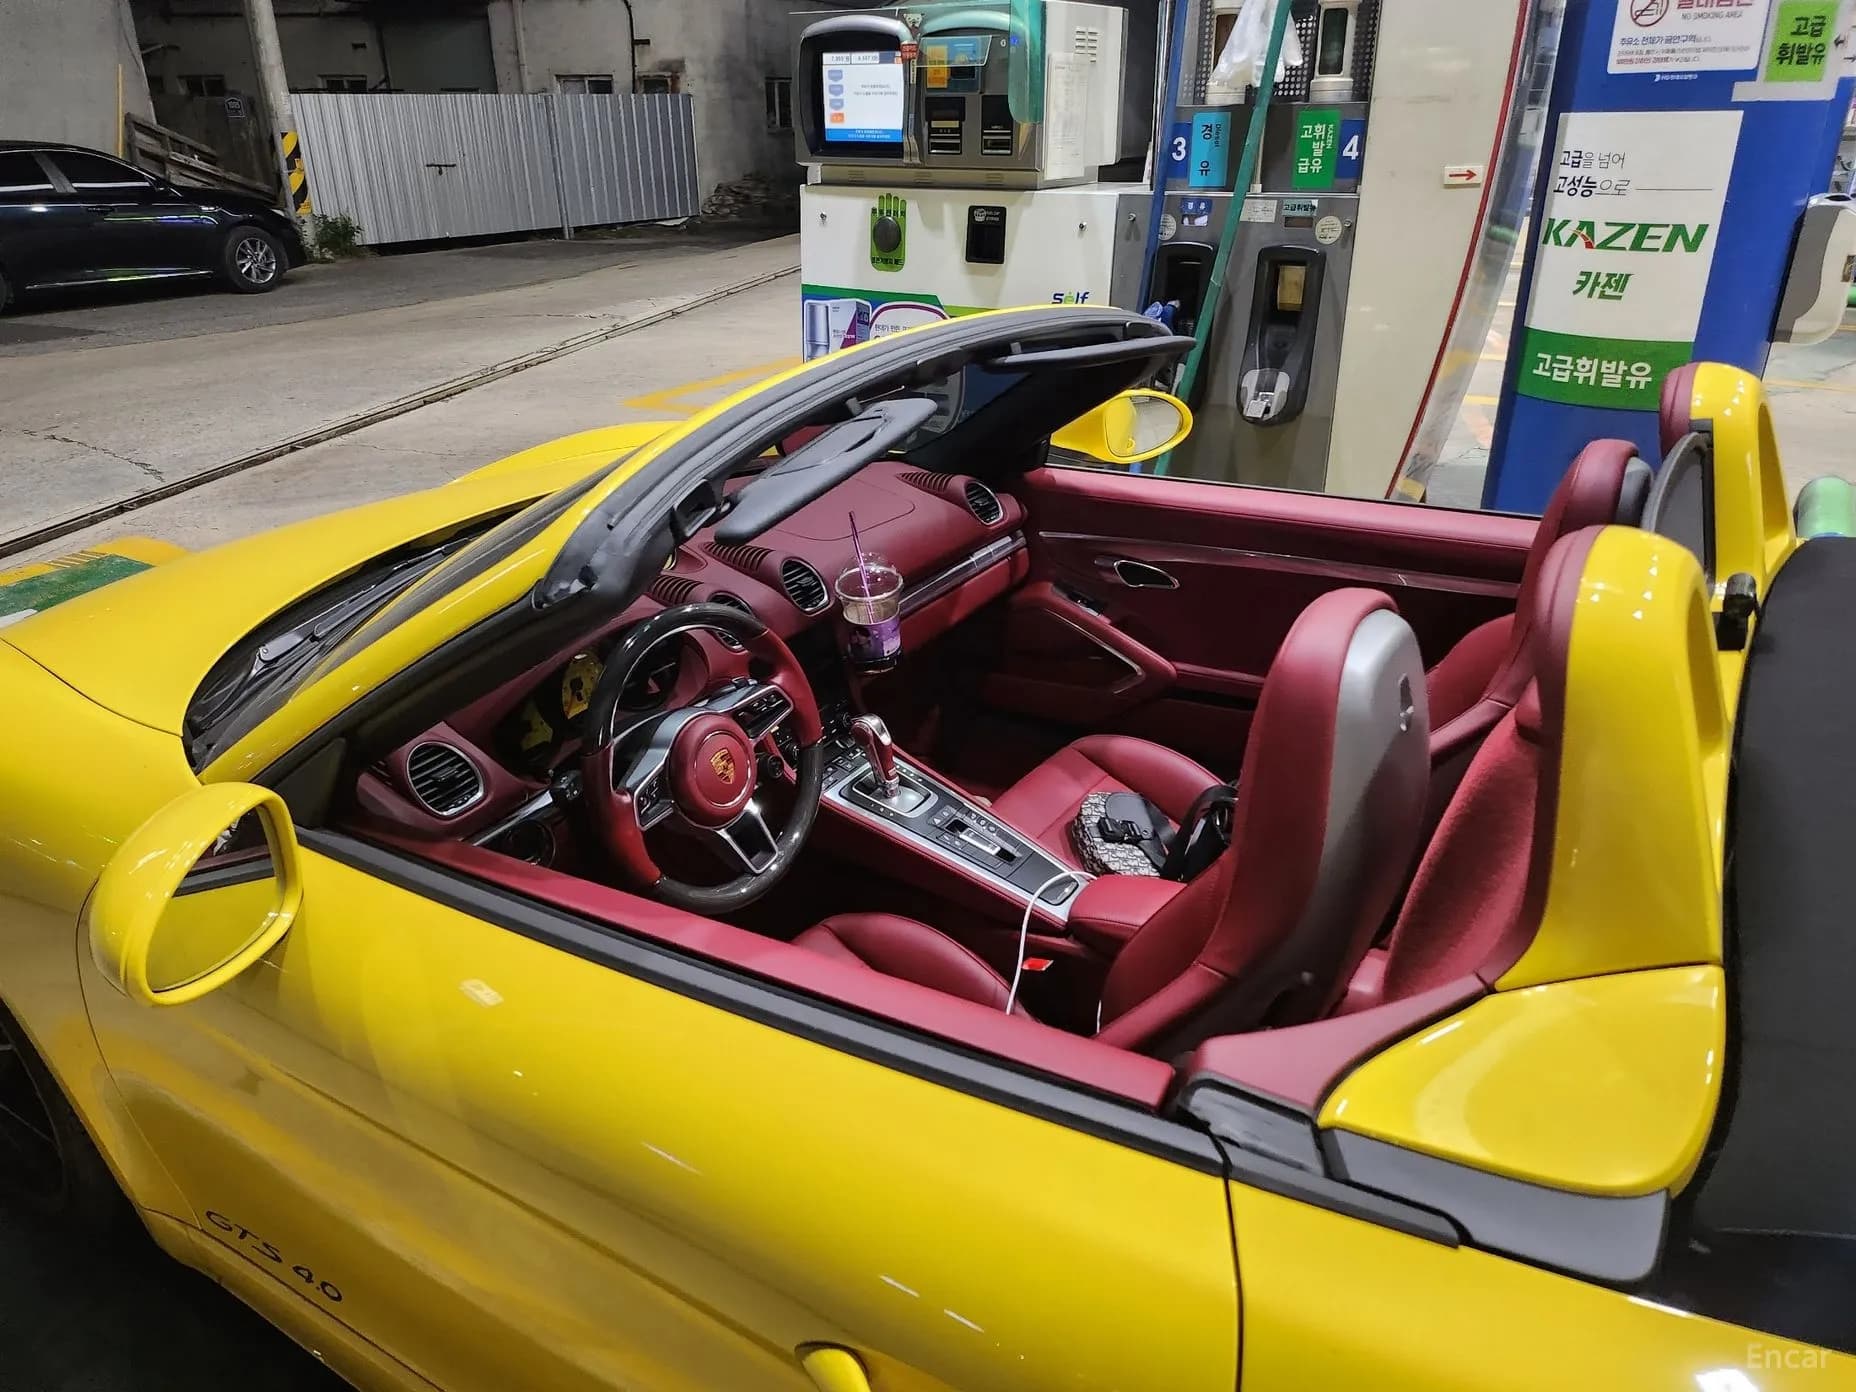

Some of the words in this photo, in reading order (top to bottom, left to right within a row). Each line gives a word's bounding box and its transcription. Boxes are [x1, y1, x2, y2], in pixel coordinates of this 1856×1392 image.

[1681, 12, 1692, 20] NO
[1693, 11, 1723, 20] SMOKING
[1724, 10, 1744, 18] AREA
[1790, 15, 1827, 37] 고급
[1776, 42, 1826, 65] 휘발유
[1171, 136, 1188, 161] 3
[1325, 124, 1334, 149] KAZEN
[1342, 134, 1360, 160] 4
[1559, 150, 1594, 168] 고급을
[1598, 151, 1625, 168] 넘어
[1553, 175, 1631, 197] 고성능으로
[1542, 218, 1709, 253] KAZEN
[1572, 270, 1635, 301] 카젠
[1532, 352, 1653, 390] 고급휘발유
[205, 1210, 283, 1264] GTS
[292, 1265, 343, 1303] 4.0
